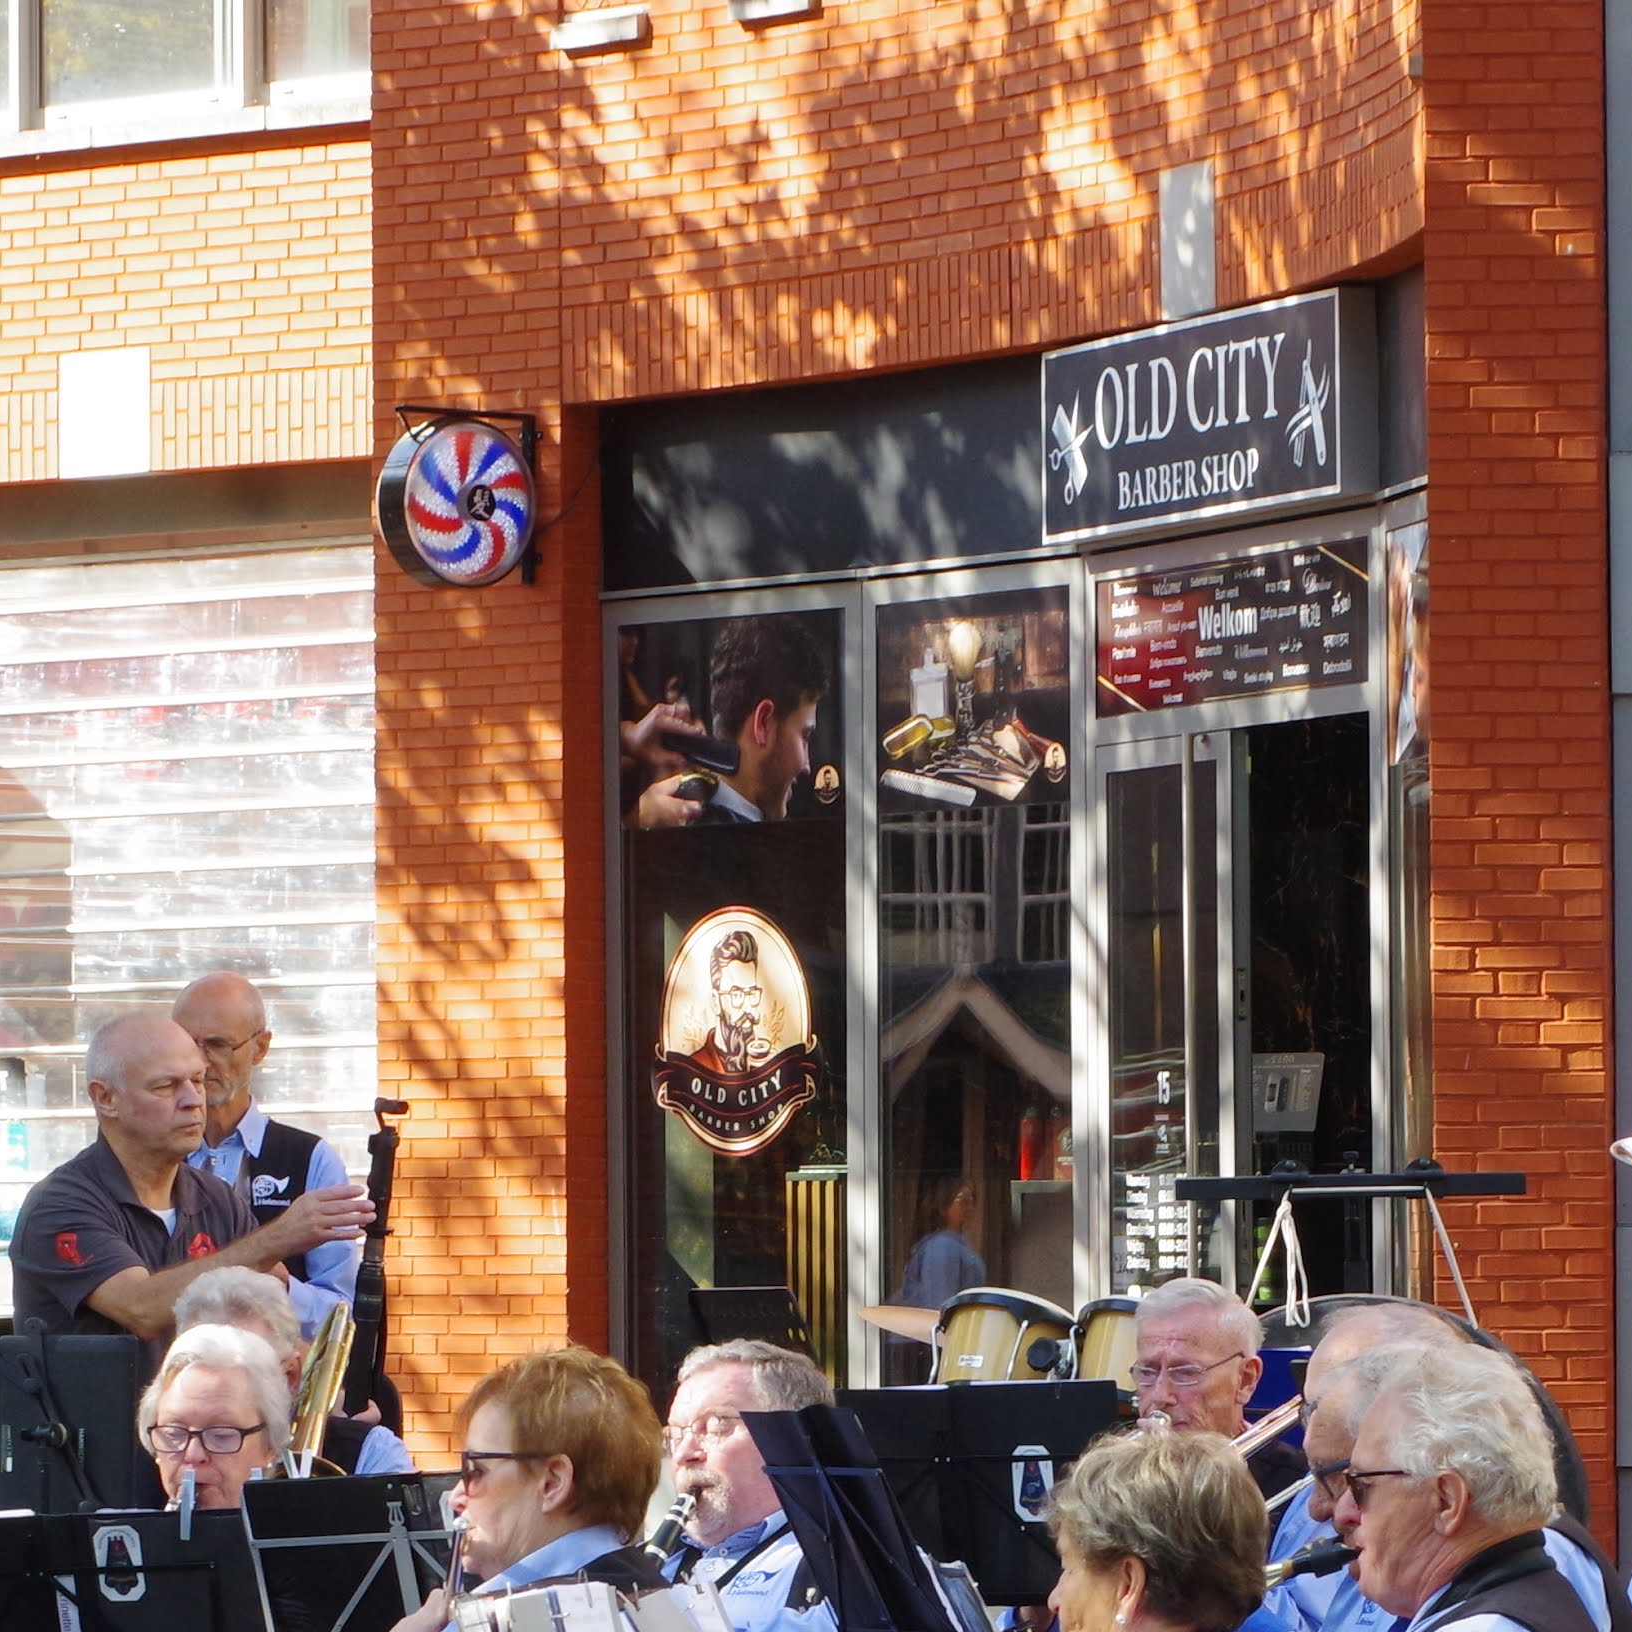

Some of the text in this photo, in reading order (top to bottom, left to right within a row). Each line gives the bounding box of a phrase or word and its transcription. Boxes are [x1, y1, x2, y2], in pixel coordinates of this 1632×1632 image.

[1095, 332, 1285, 450] OLD CITY
[1118, 448, 1260, 511] BARBER SHOP
[1198, 602, 1258, 641] Welkom
[691, 1069, 783, 1107] OLD CITY
[1157, 1071, 1170, 1104] 15
[689, 1103, 784, 1132] BARBER SHOP
